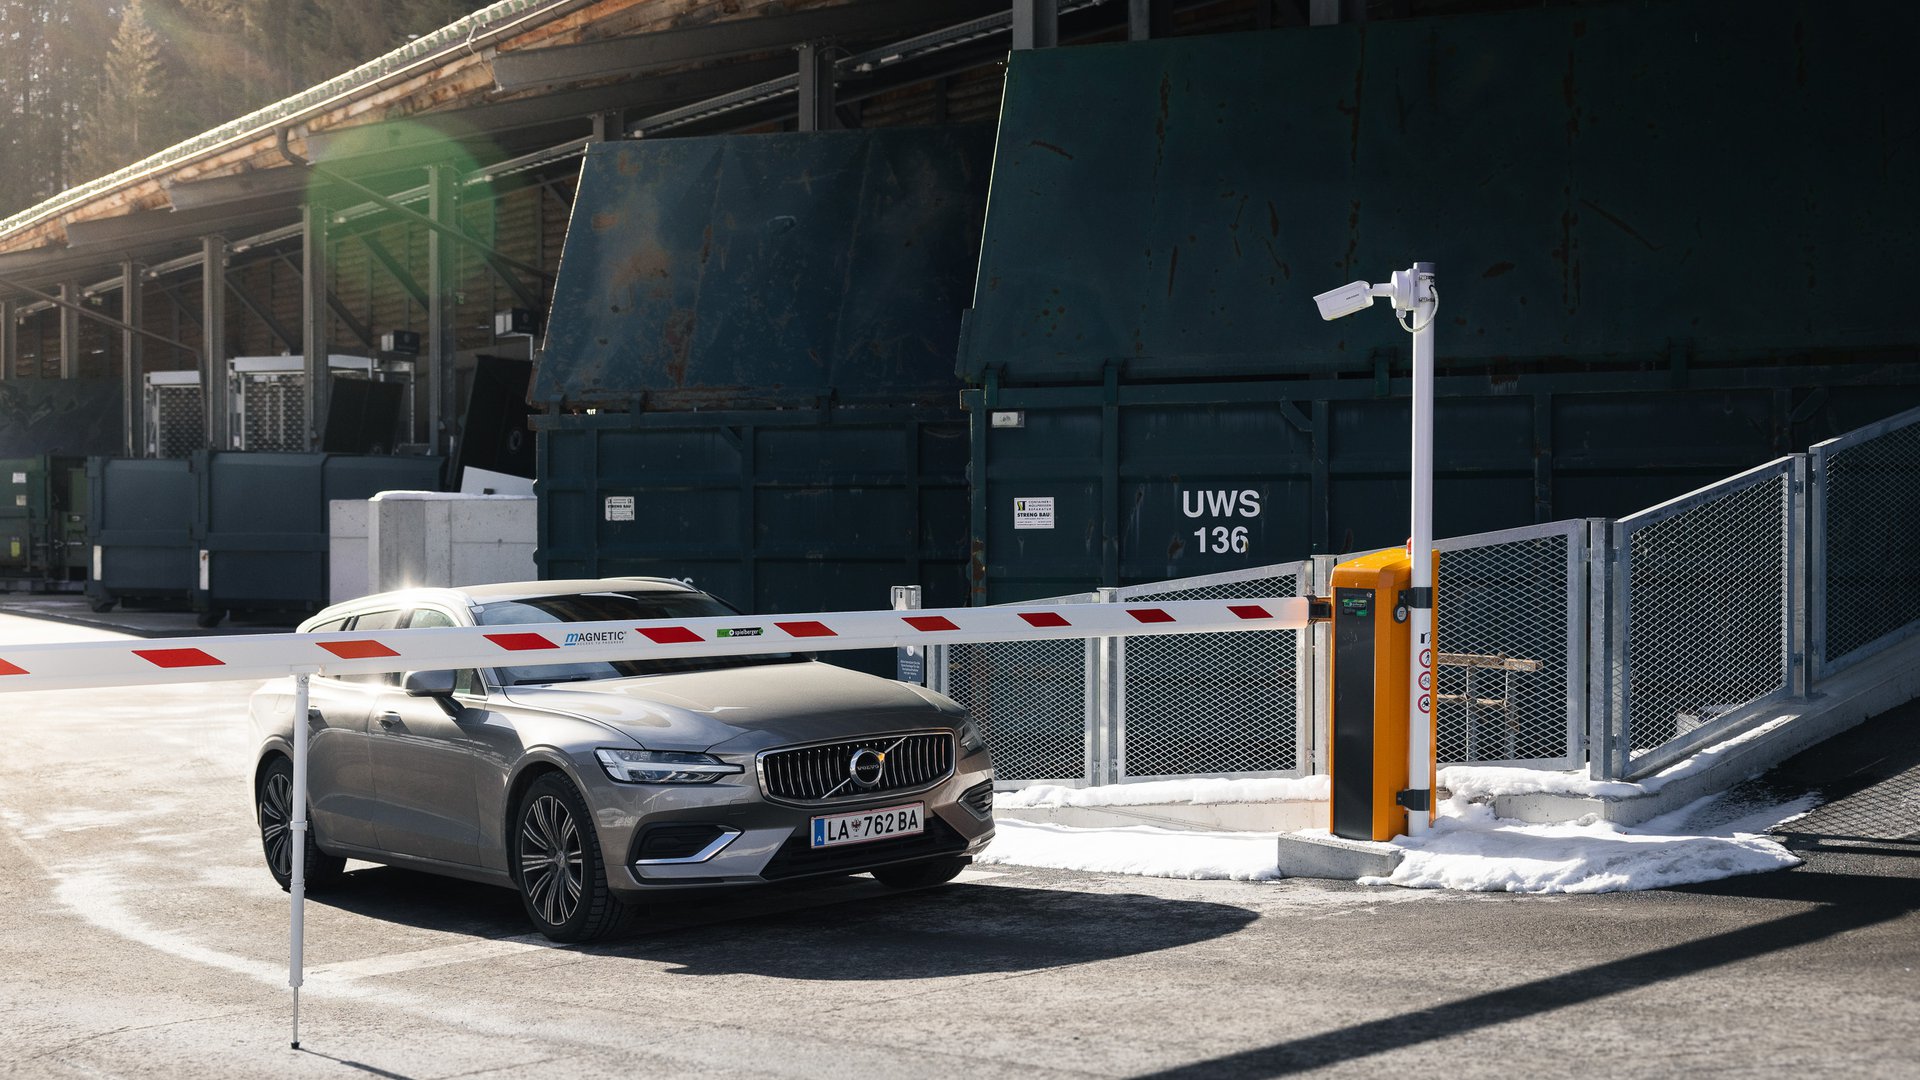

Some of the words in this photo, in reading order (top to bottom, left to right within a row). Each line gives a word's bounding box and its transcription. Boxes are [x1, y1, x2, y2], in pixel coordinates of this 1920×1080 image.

[1183, 489, 1260, 518] UWS
[1194, 526, 1249, 553] 136
[828, 819, 850, 841] LA
[864, 813, 894, 837] 762
[898, 809, 918, 832] BA
